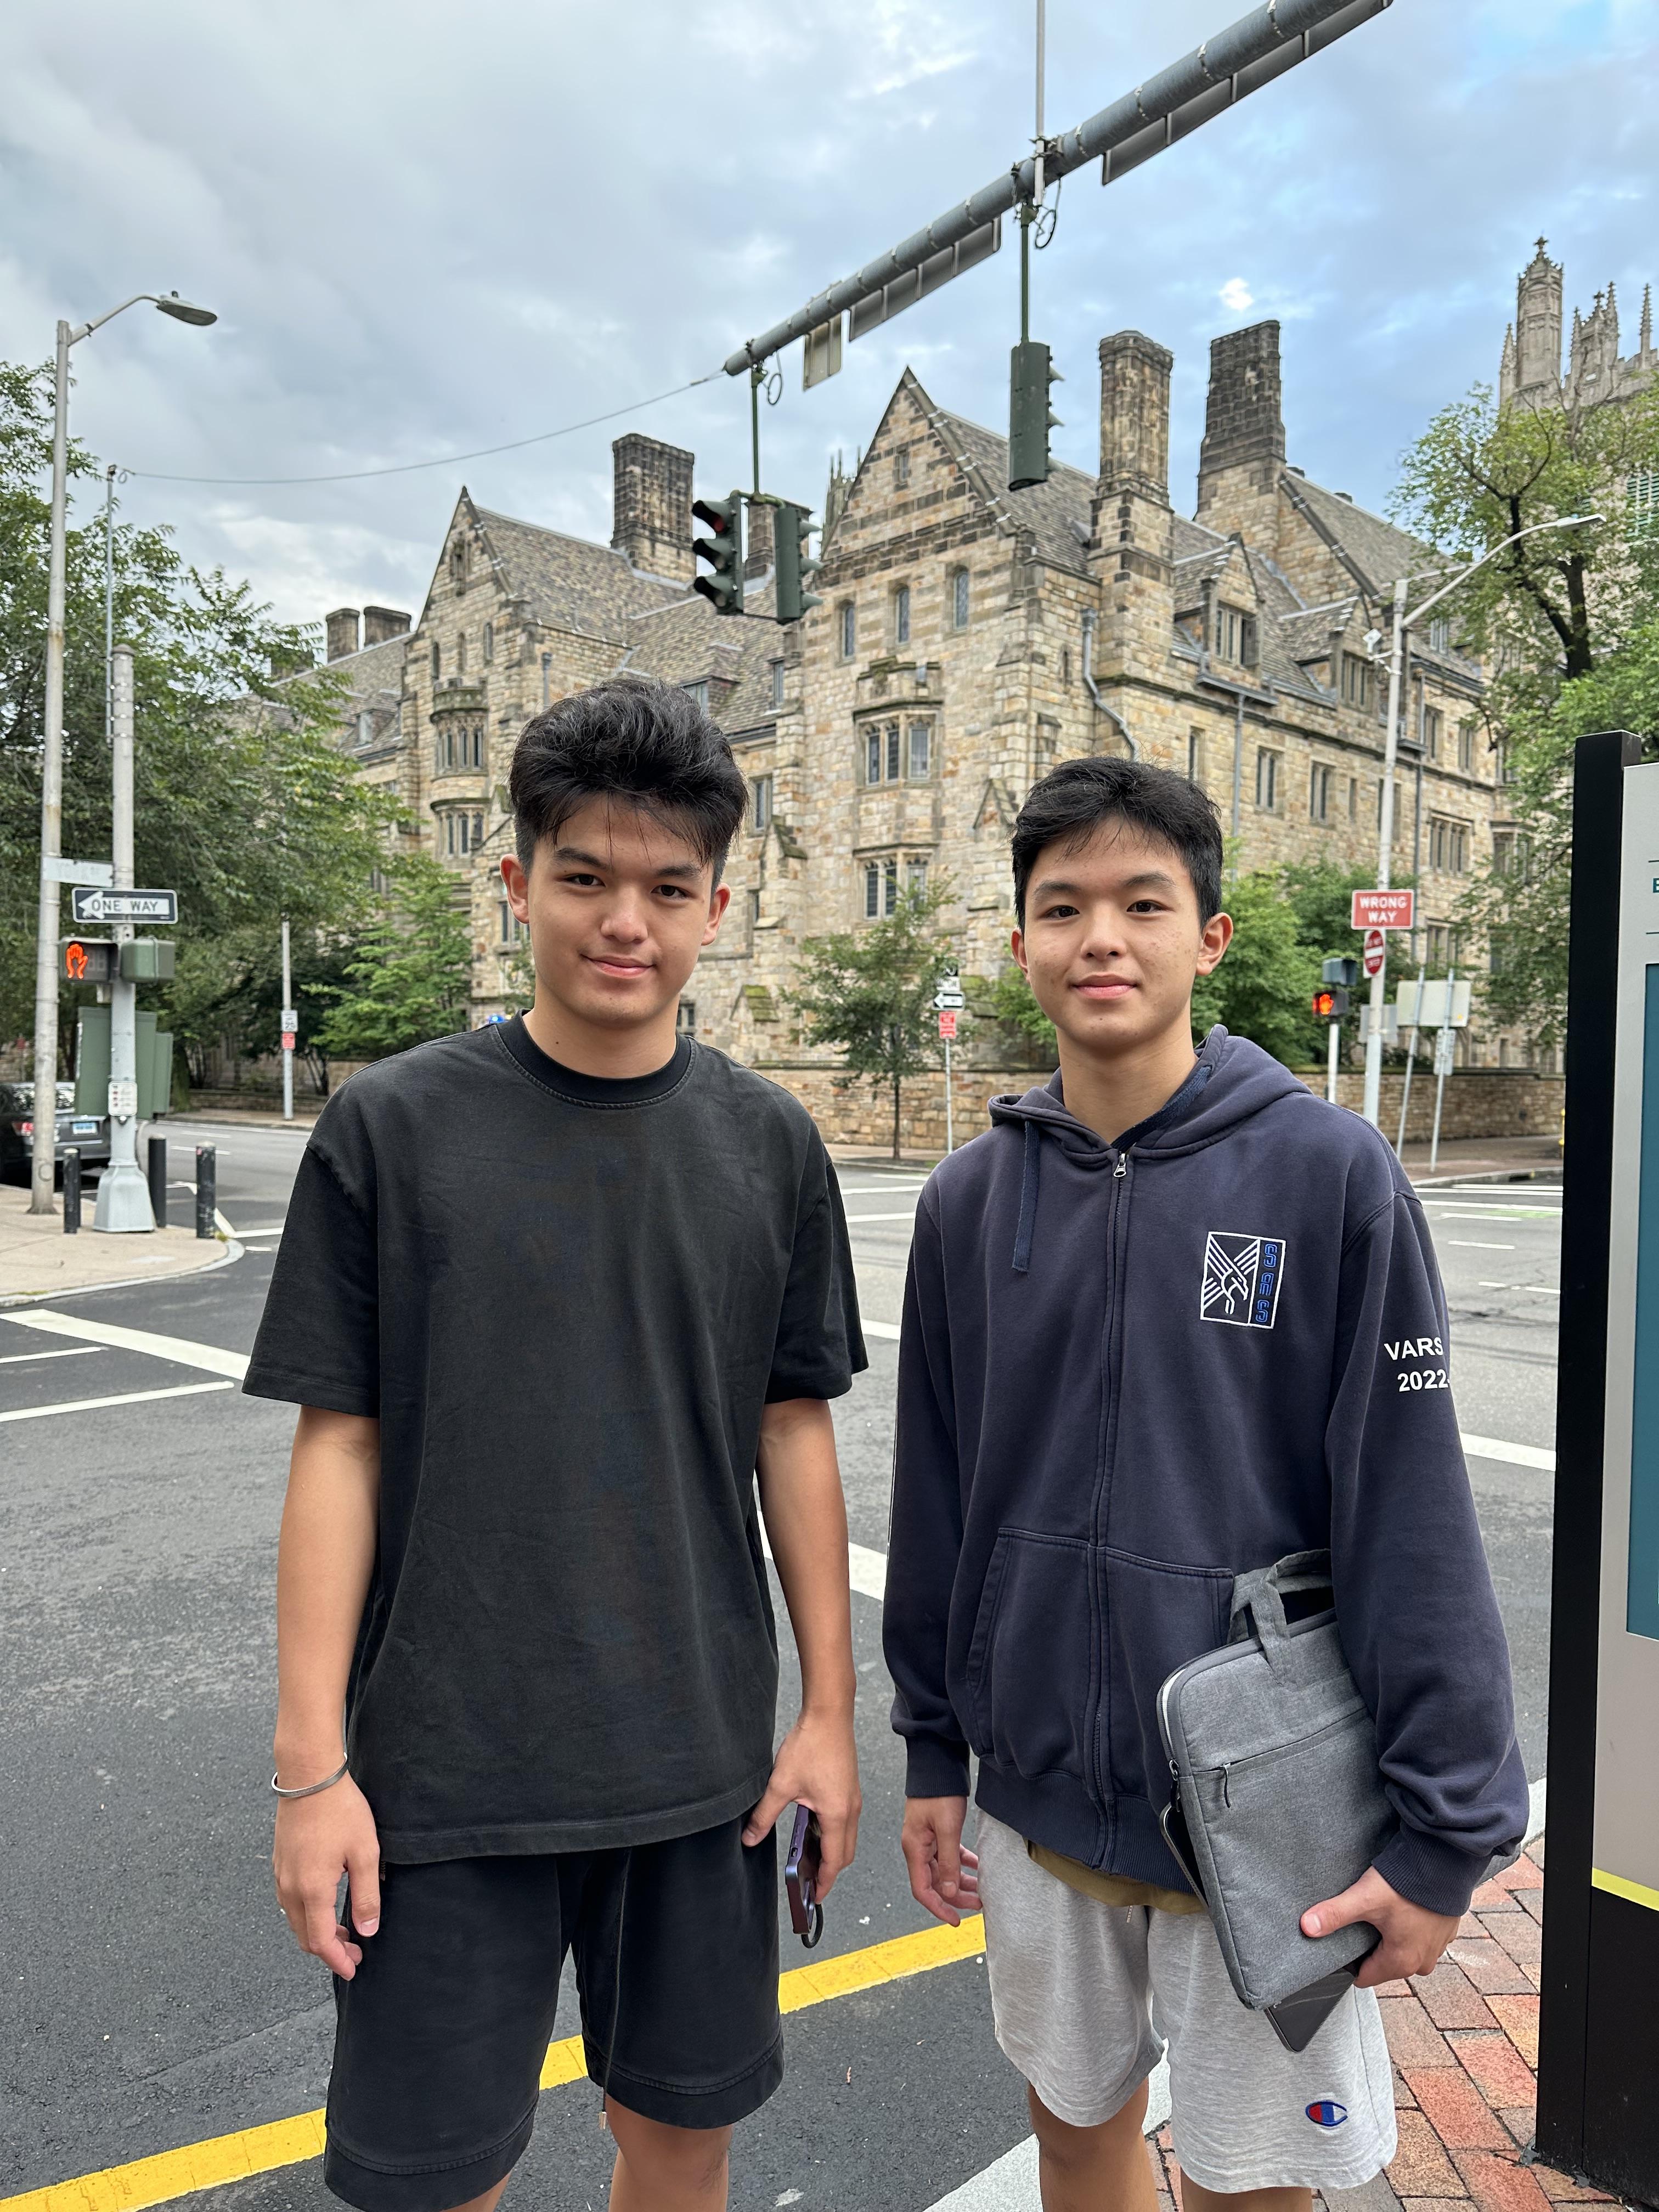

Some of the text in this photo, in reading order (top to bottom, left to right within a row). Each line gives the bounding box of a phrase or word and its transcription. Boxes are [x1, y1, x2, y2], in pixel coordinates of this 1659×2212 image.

[92, 898, 159, 912] ONE WAY
[1359, 896, 1408, 909] WRONG
[1368, 910, 1398, 923] WAY
